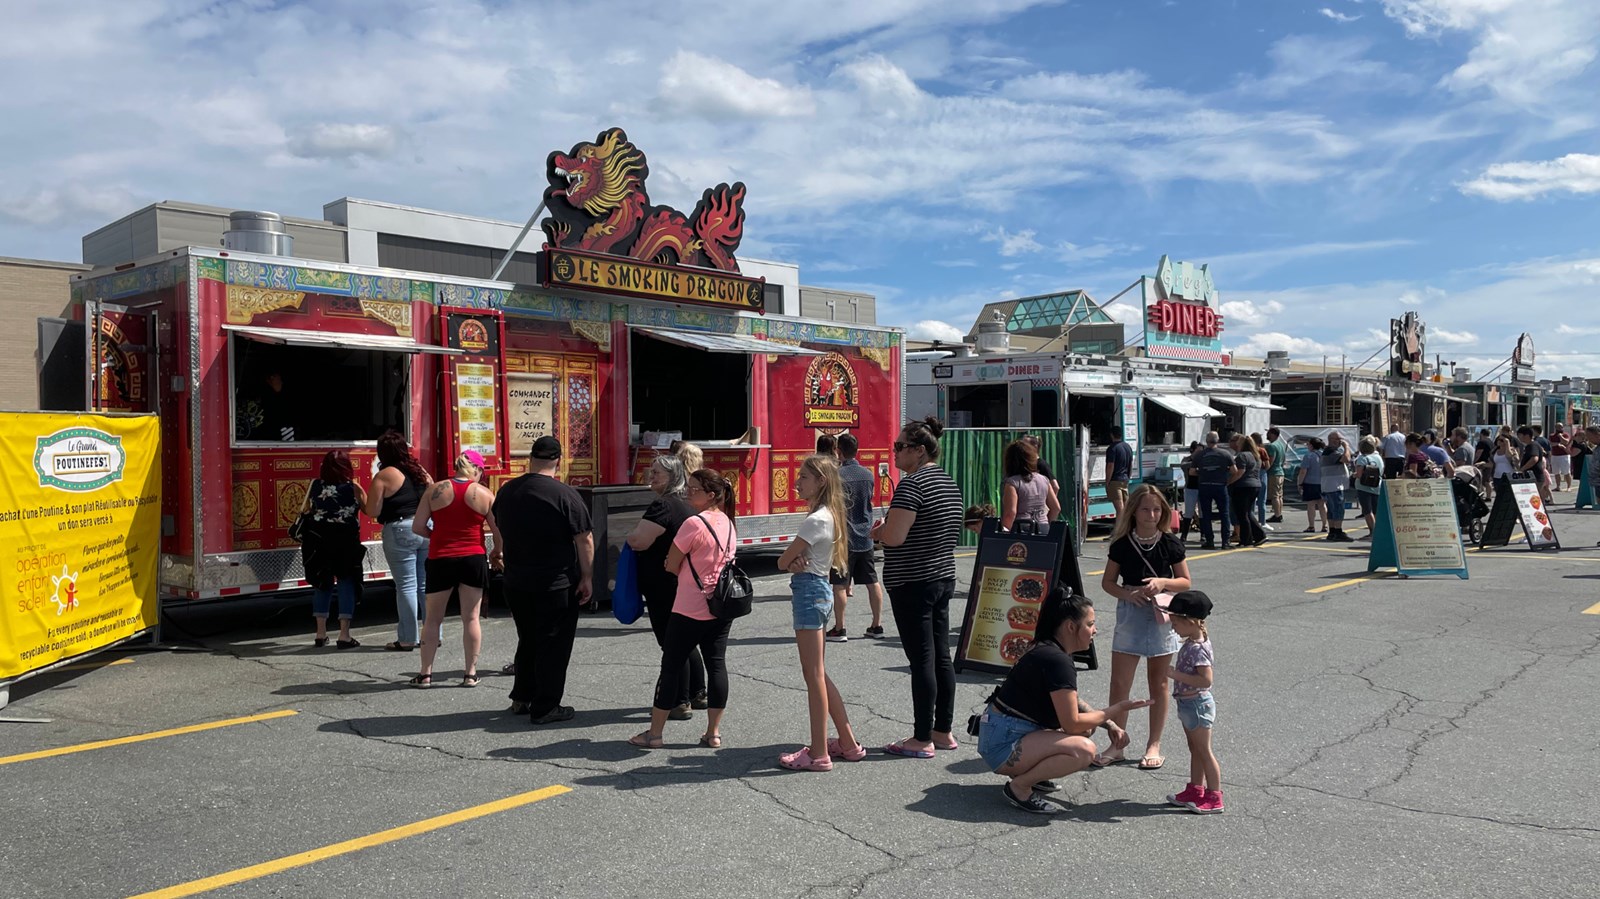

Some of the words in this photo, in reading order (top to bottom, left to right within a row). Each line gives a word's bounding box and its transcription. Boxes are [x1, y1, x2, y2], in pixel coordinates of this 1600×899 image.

[579, 258, 600, 283] LE
[608, 263, 680, 294] SMOKING
[687, 274, 744, 301] DRAGON
[1161, 300, 1216, 338] DINER
[1007, 364, 1040, 376] DINER
[509, 389, 551, 399] COMMANDEZ
[811, 411, 817, 420] LE
[515, 421, 546, 430] RECEVEZ
[67, 440, 76, 452] Le
[76, 439, 97, 454] Grand
[56, 456, 108, 470] POUTINEFEST
[39, 506, 64, 517] Poutine
[65, 503, 71, 515] &
[71, 504, 83, 514] son
[83, 502, 95, 515] plat
[95, 498, 127, 510] Réutilisable
[127, 499, 135, 507] ou
[58, 521, 67, 531] un
[67, 518, 79, 530] don
[80, 517, 93, 528] sera
[94, 514, 109, 525] versé
[109, 513, 114, 523] à
[16, 552, 66, 575] opération
[56, 624, 71, 635] every
[71, 619, 90, 632] poutine
[90, 615, 100, 625] and
[118, 607, 123, 616] or
[20, 643, 50, 661] recyclable
[121, 618, 126, 627] be
